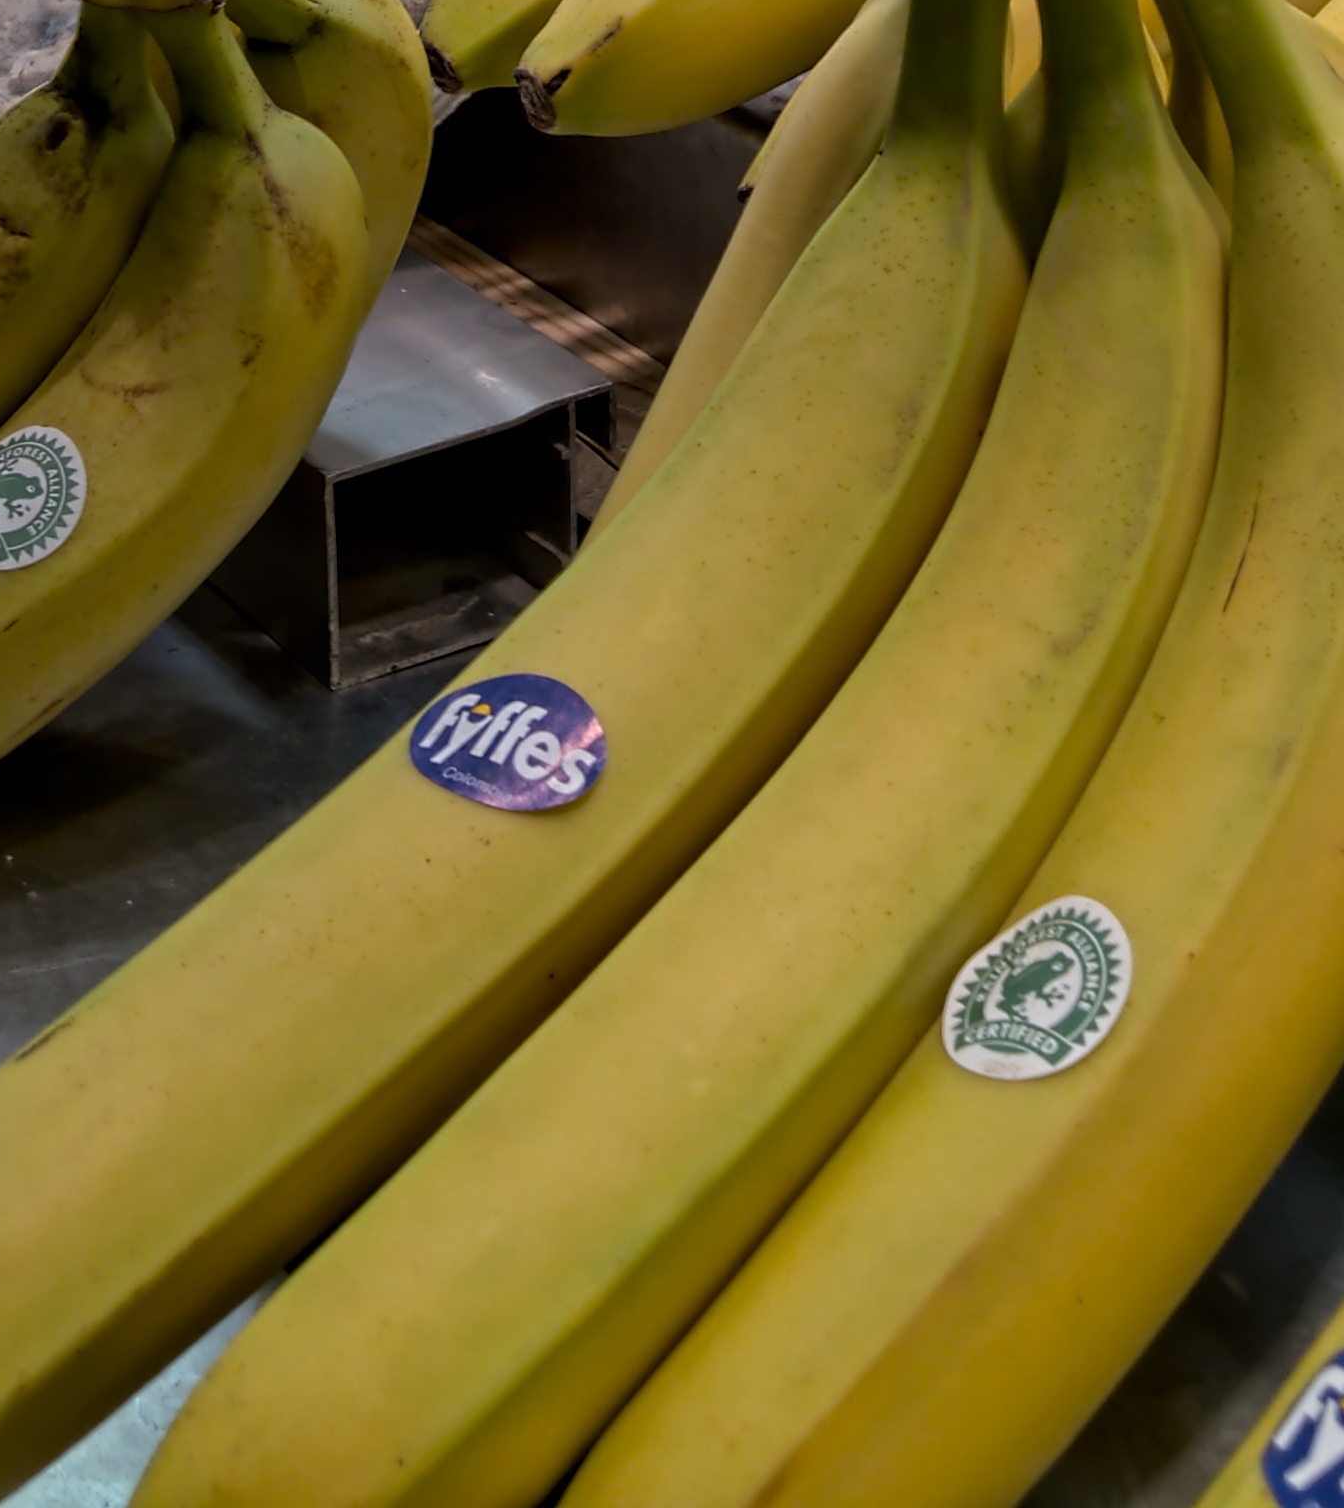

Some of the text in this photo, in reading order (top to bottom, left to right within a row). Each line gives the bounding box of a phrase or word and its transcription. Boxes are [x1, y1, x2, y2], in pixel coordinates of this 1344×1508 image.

[26, 469, 63, 536] ALLIANCE
[418, 693, 597, 796] fyffes
[442, 765, 515, 804] Colombia
[963, 1024, 1060, 1056] CERTIFIED
